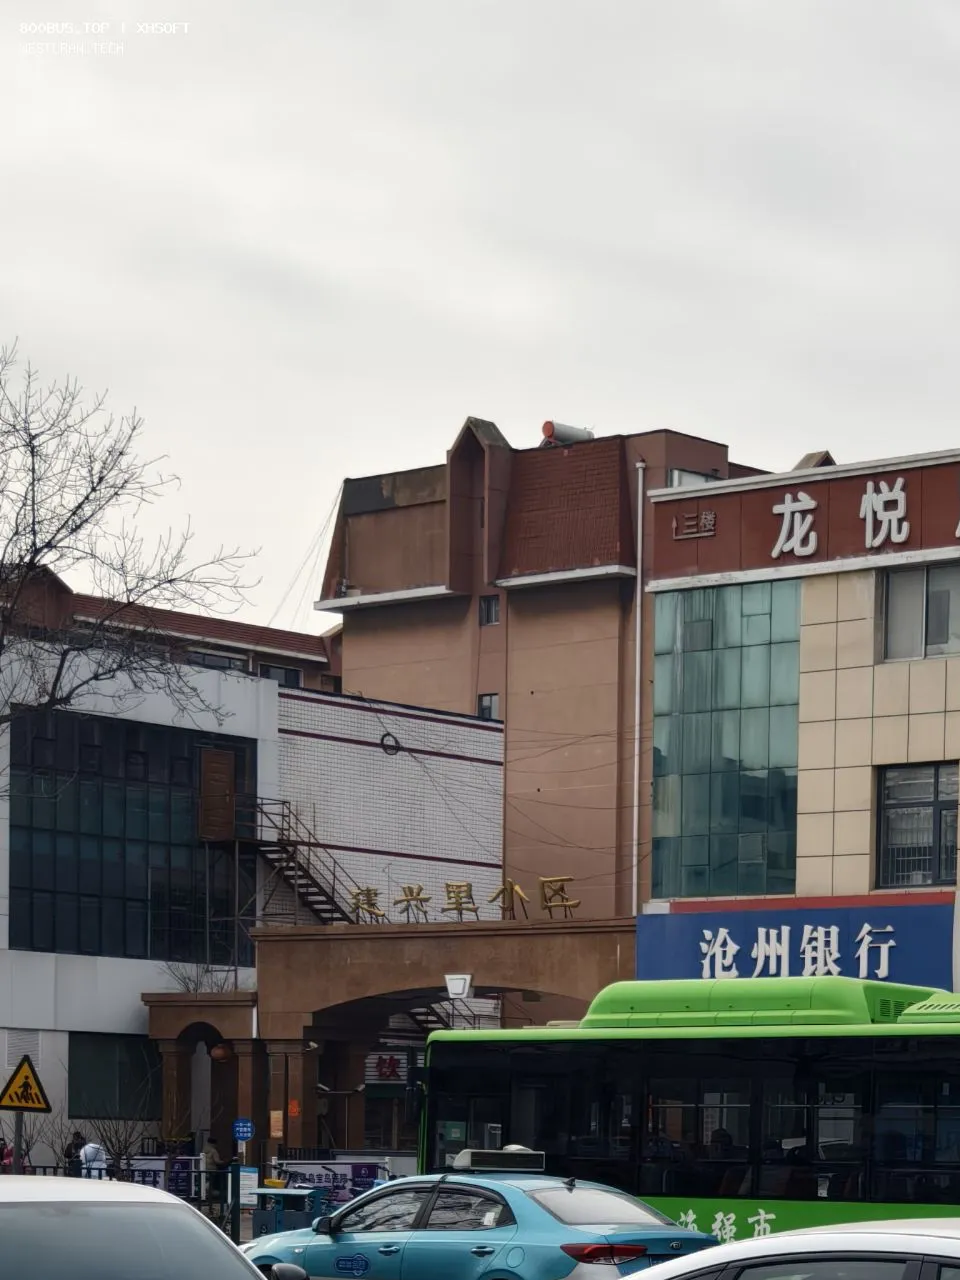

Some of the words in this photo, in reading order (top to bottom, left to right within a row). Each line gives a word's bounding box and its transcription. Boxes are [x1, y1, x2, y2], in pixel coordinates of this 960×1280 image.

[682, 511, 717, 533] 三楼
[700, 922, 897, 979] 沧州银行
